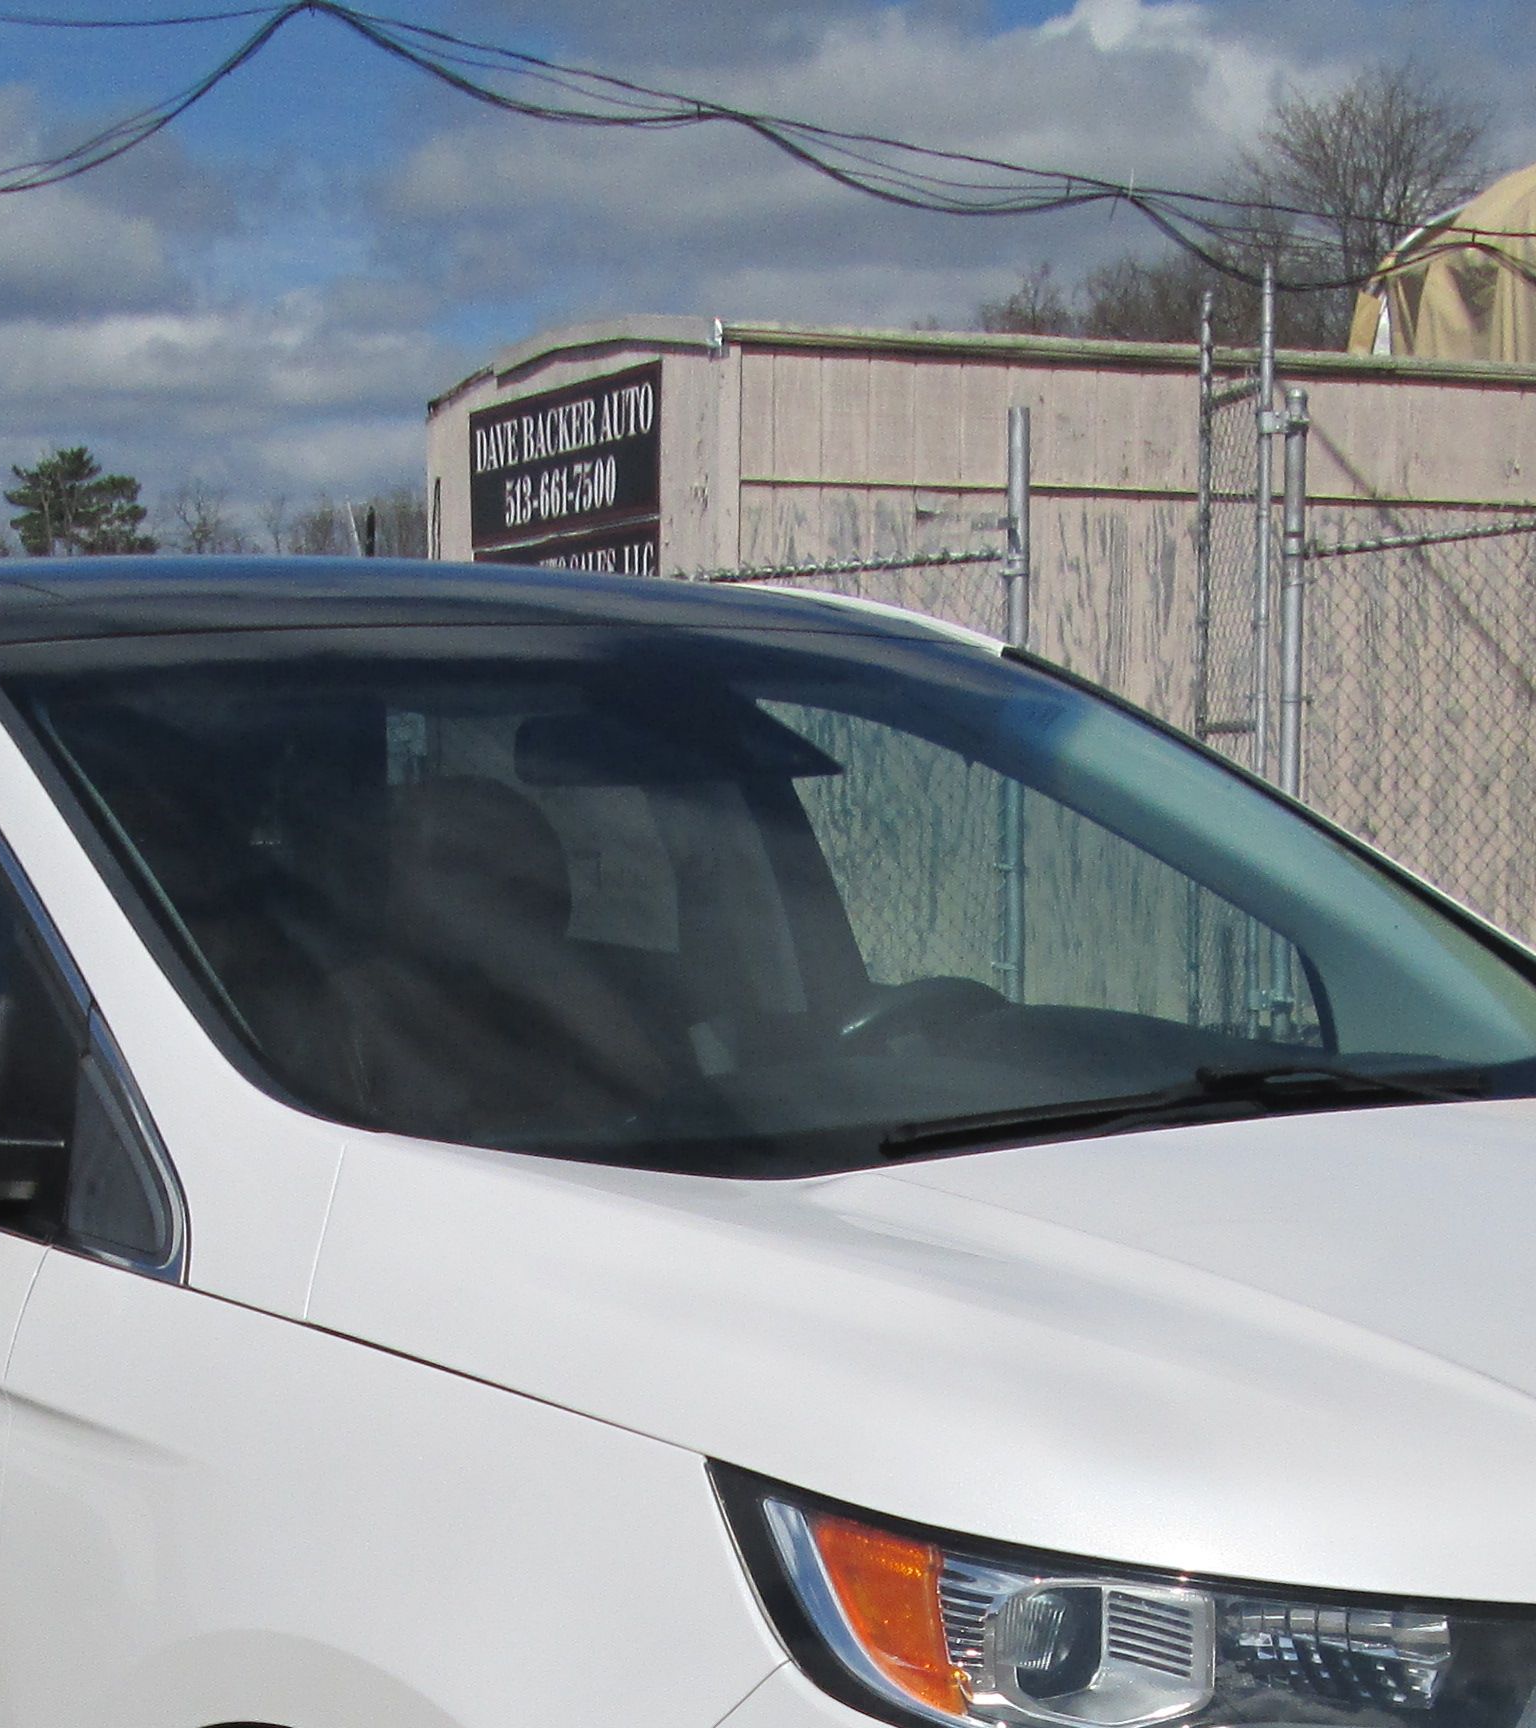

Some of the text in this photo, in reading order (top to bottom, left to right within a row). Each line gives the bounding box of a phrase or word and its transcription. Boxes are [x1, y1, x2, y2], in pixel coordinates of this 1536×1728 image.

[476, 381, 654, 473] DAVE BACKER AUTO
[505, 454, 616, 527] 513-661-7500
